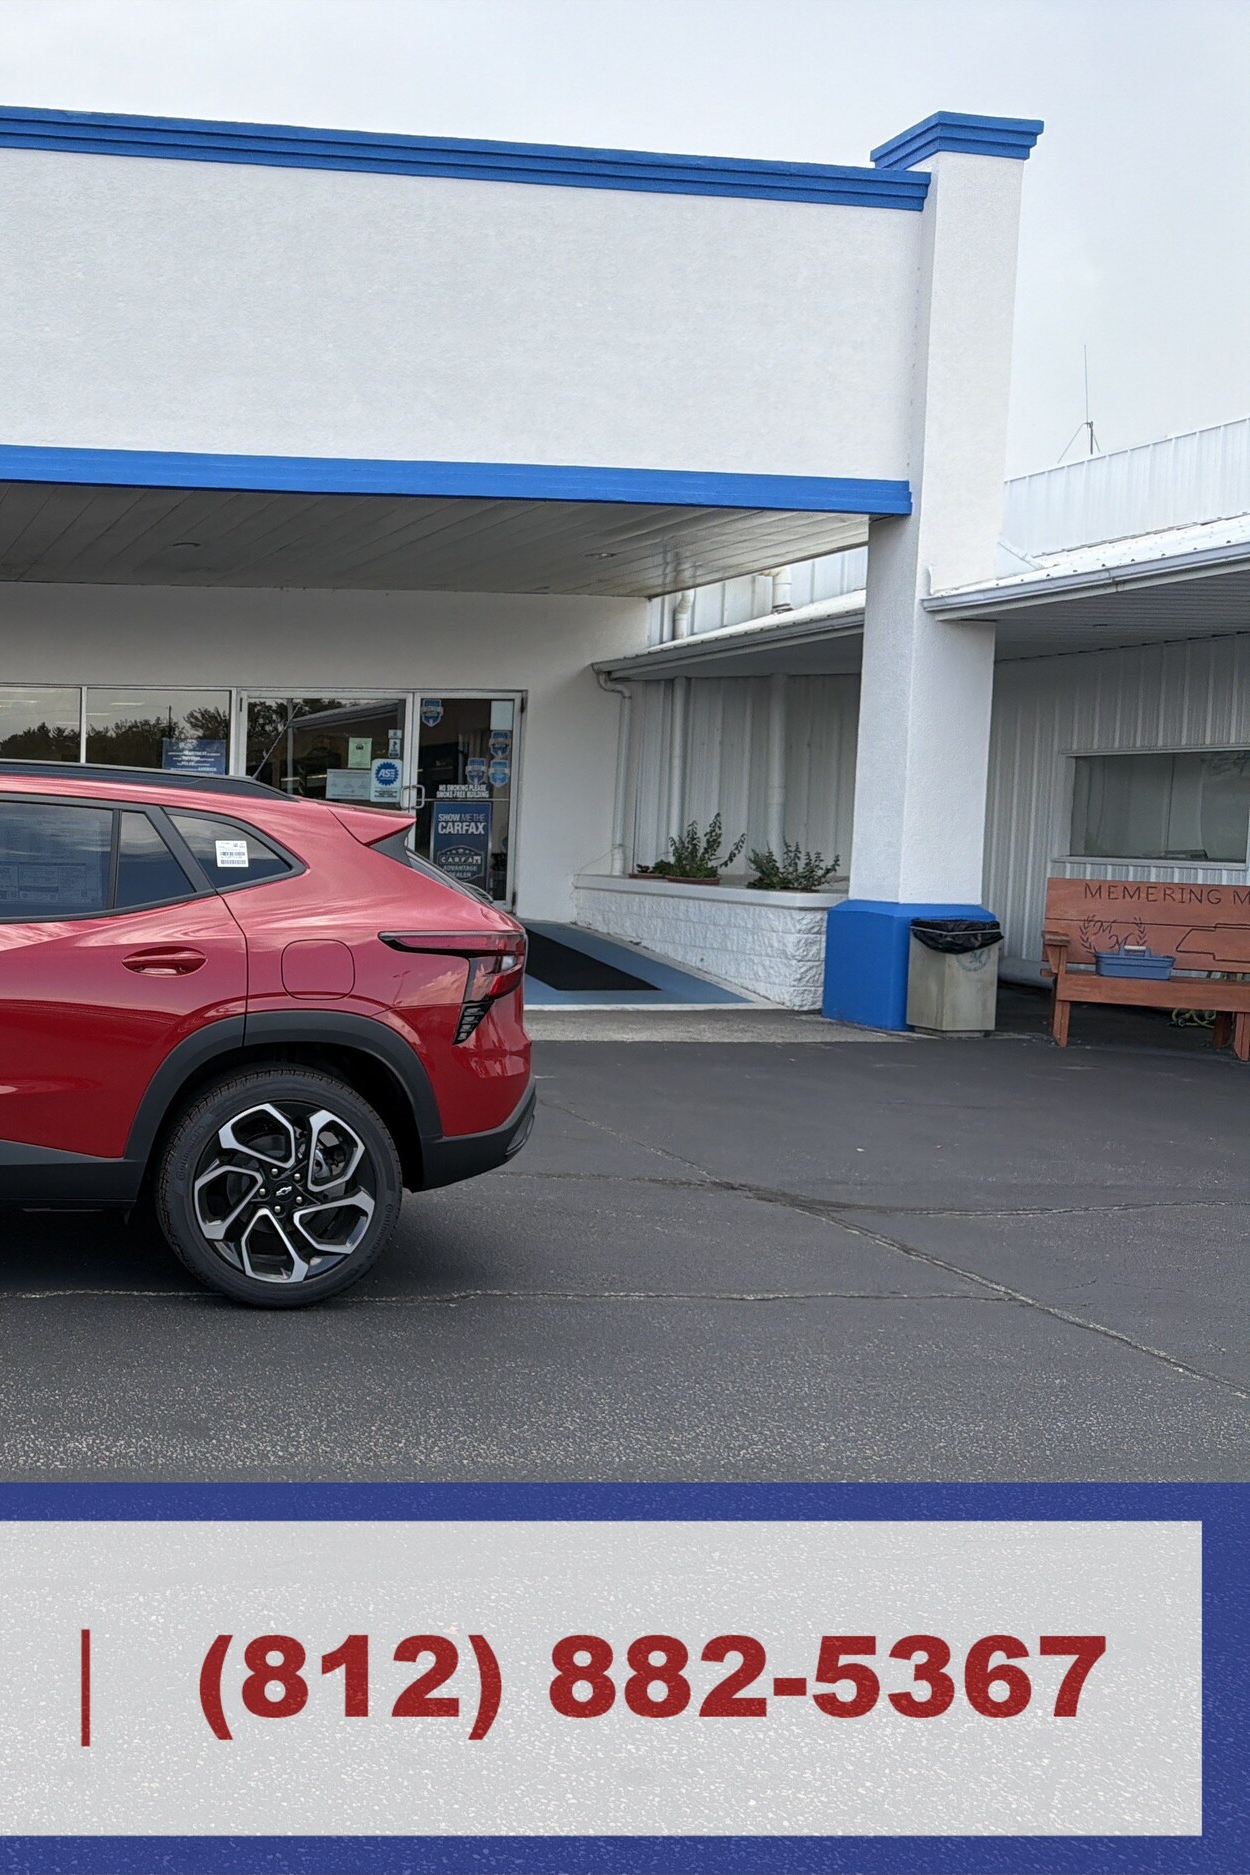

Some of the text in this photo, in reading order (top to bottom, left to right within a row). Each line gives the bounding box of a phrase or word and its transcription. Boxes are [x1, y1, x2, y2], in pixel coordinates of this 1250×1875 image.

[377, 768, 396, 778] ASE
[438, 814, 460, 822] SHOW
[438, 822, 486, 834] CARFAX
[1084, 883, 1222, 905] MEMERING
